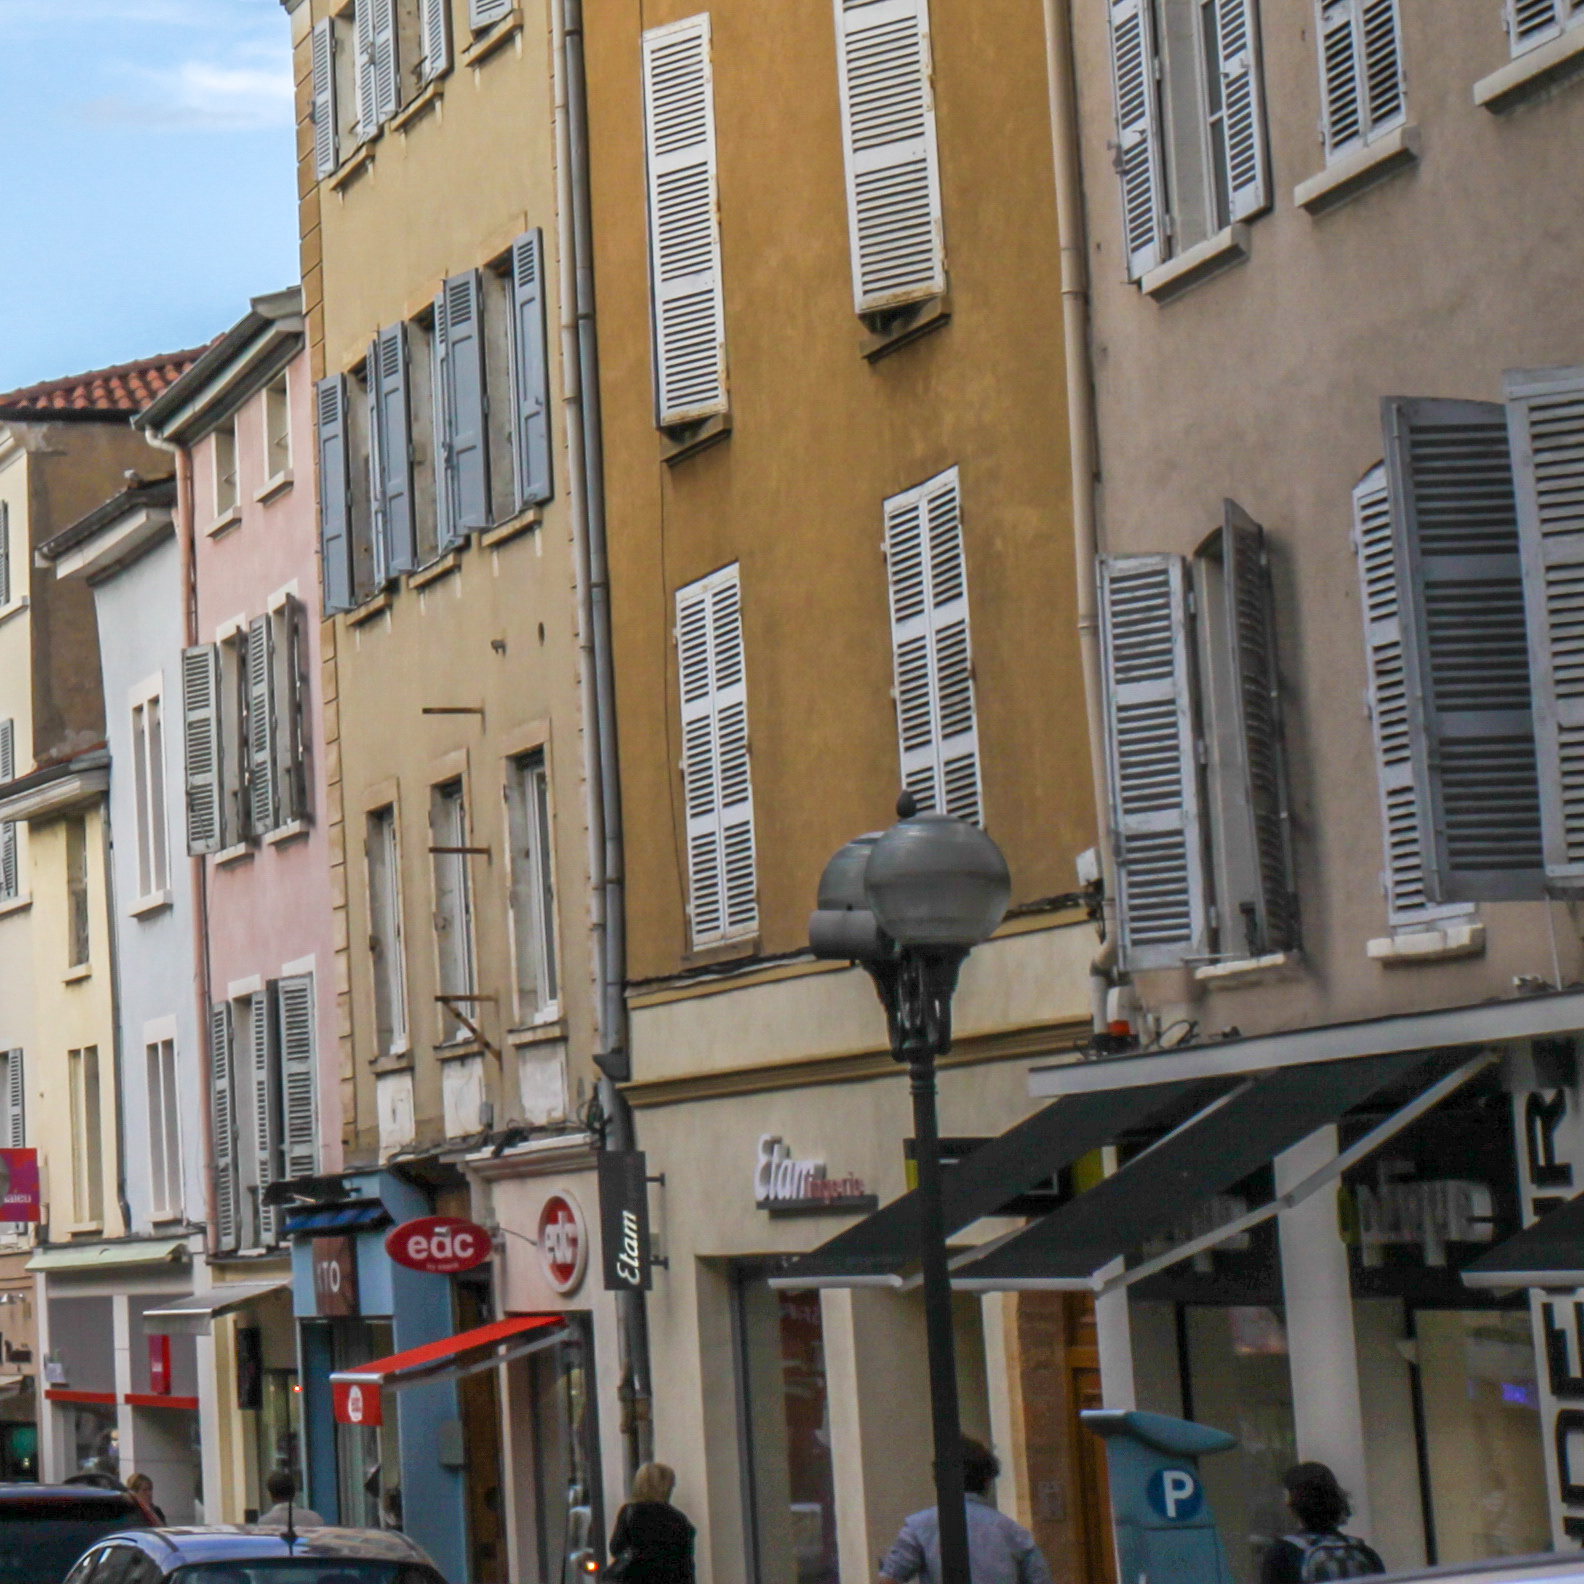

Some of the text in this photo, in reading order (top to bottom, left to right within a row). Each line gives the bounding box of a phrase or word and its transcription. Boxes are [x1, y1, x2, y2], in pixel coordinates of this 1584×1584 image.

[407, 1226, 475, 1260] edc
[617, 1210, 641, 1286] Etam
[1163, 1469, 1195, 1518] P
